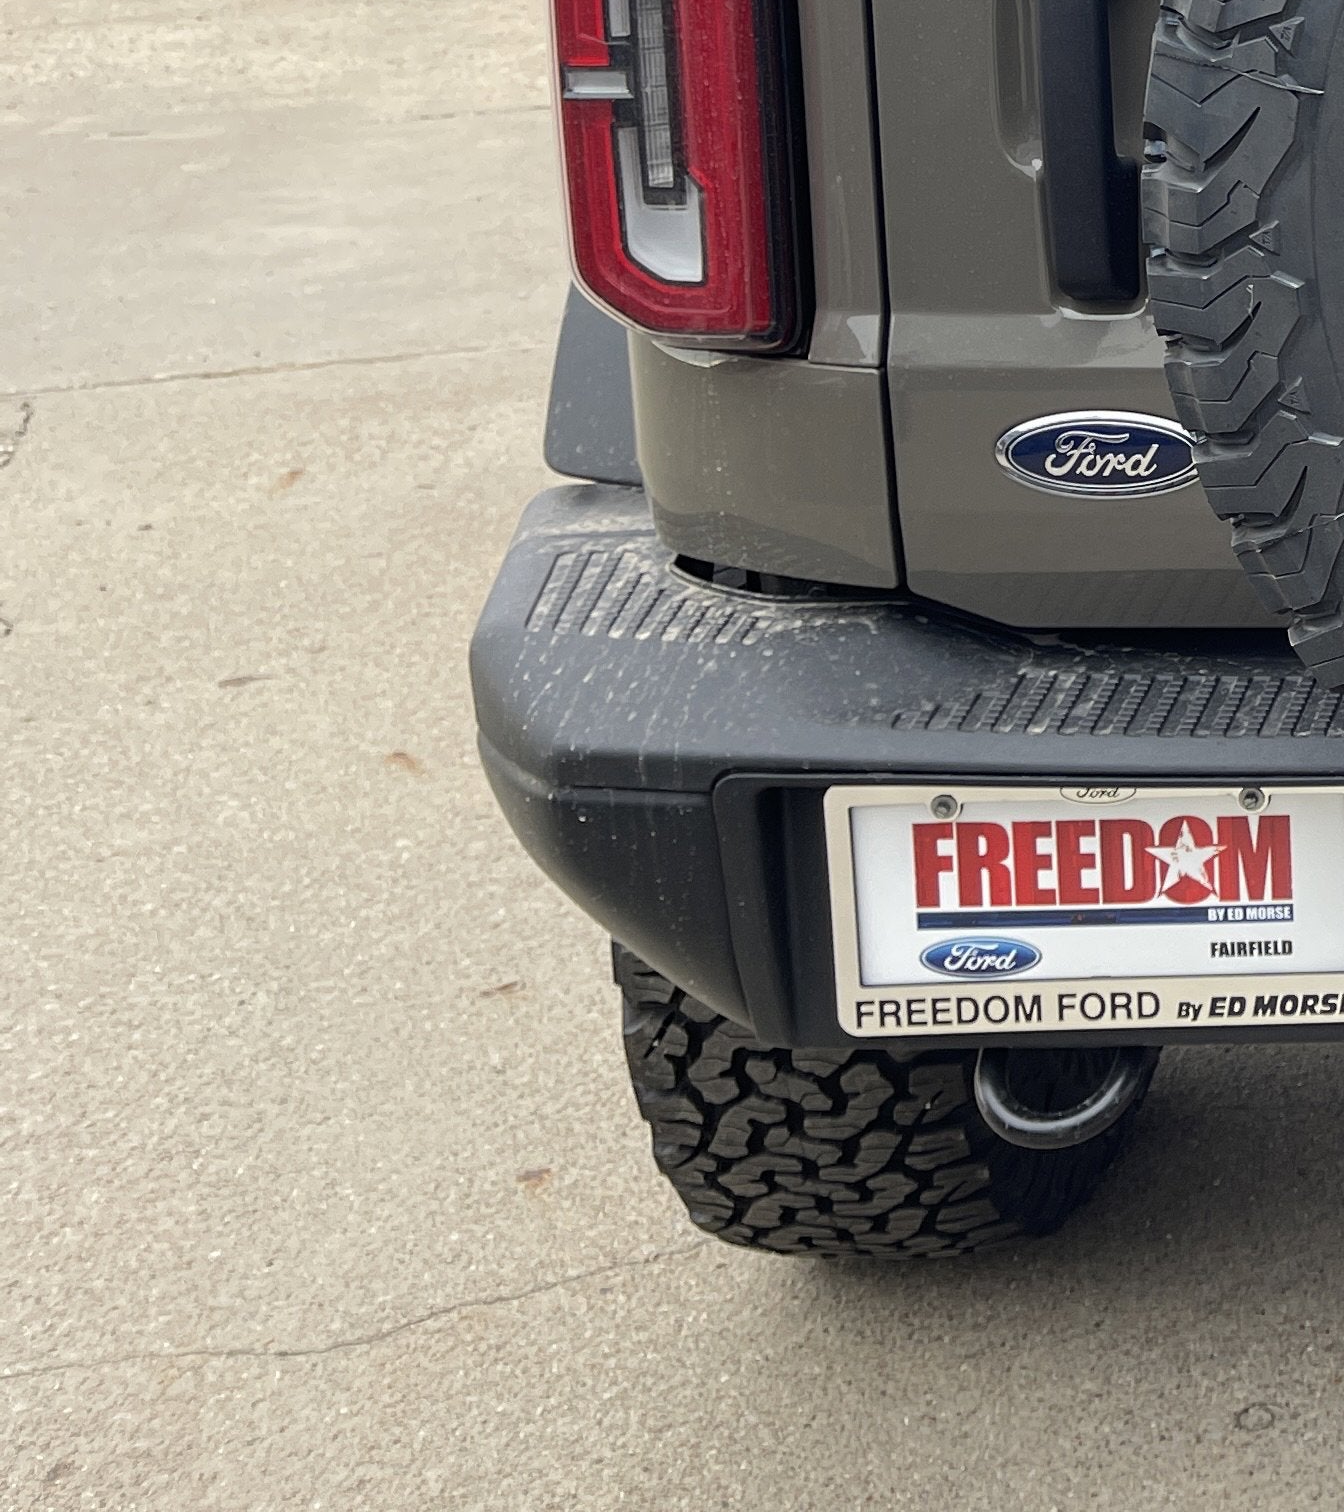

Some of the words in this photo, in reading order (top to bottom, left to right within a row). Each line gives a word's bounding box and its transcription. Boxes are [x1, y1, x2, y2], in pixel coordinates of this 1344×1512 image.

[1044, 430, 1160, 477] Ford
[1076, 786, 1121, 800] Ford
[912, 814, 1293, 908] FREEDOM
[1207, 908, 1226, 921] BY
[1228, 907, 1244, 921] ED
[1246, 906, 1292, 921] MORSE
[943, 939, 1018, 972] Ford
[1210, 939, 1293, 958] FAIRFIELD
[856, 994, 1043, 1029] FREEDOM
[1057, 991, 1162, 1021] FORD
[1177, 1000, 1204, 1022] By
[1207, 995, 1247, 1018] ED
